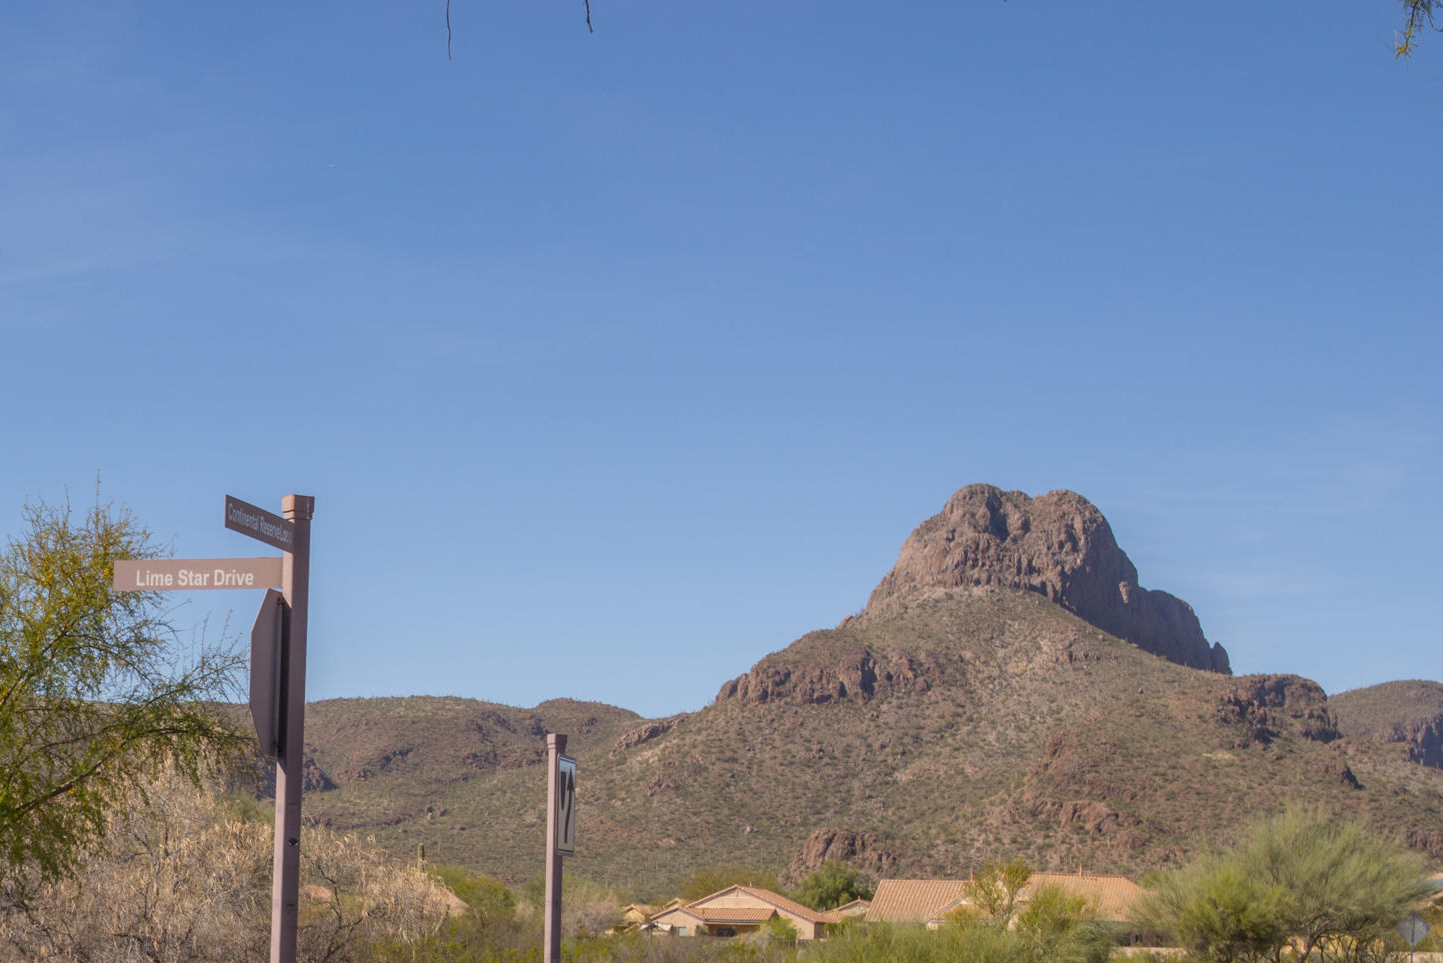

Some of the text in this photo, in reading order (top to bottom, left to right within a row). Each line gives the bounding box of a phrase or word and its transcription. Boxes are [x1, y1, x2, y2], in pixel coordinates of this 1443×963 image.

[228, 503, 260, 531] Continental
[260, 515, 281, 540] Reserve
[136, 569, 254, 587] Lime Star Drive
